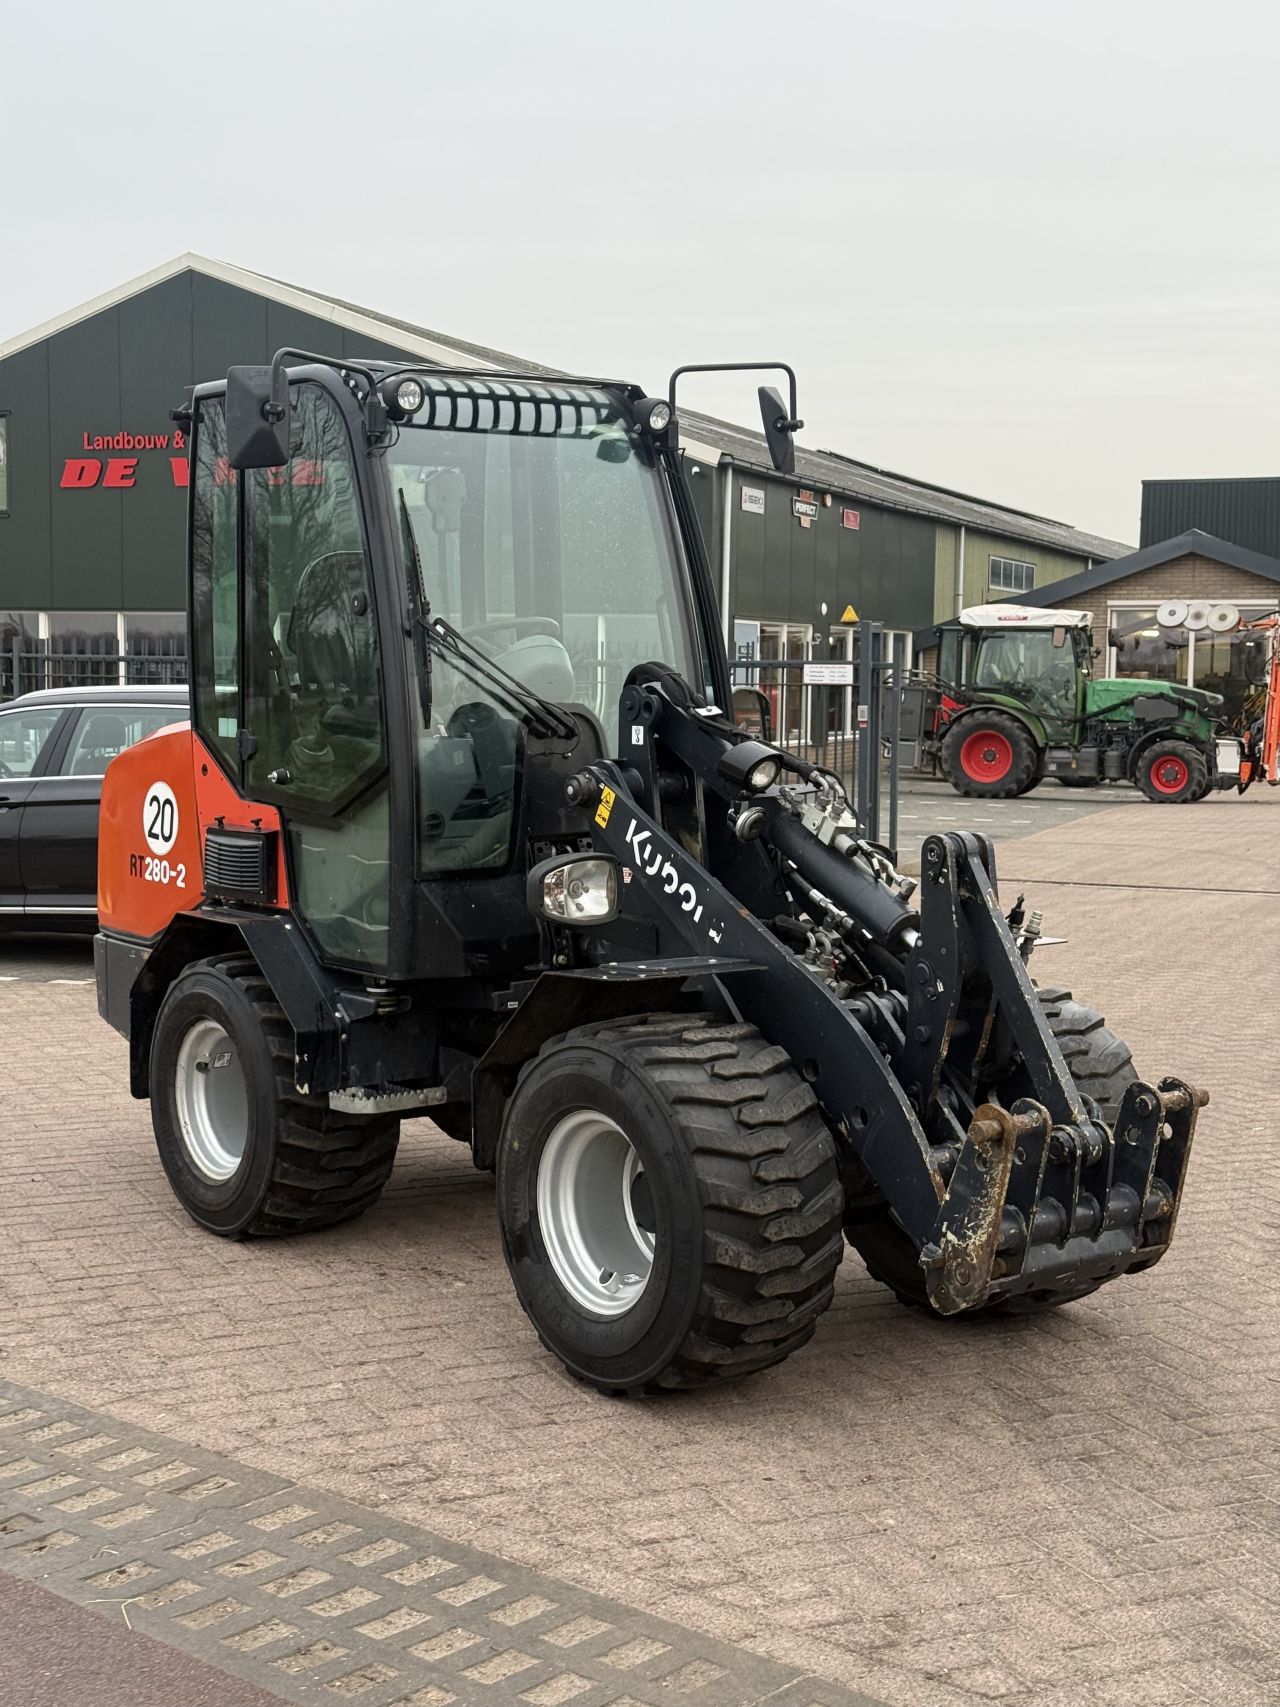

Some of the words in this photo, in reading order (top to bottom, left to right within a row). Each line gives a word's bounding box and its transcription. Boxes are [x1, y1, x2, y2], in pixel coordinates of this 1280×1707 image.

[83, 431, 169, 450] Landbouw
[172, 430, 185, 449] &
[60, 457, 138, 488] DE
[147, 795, 175, 843] 20
[129, 853, 186, 889] RT280-2
